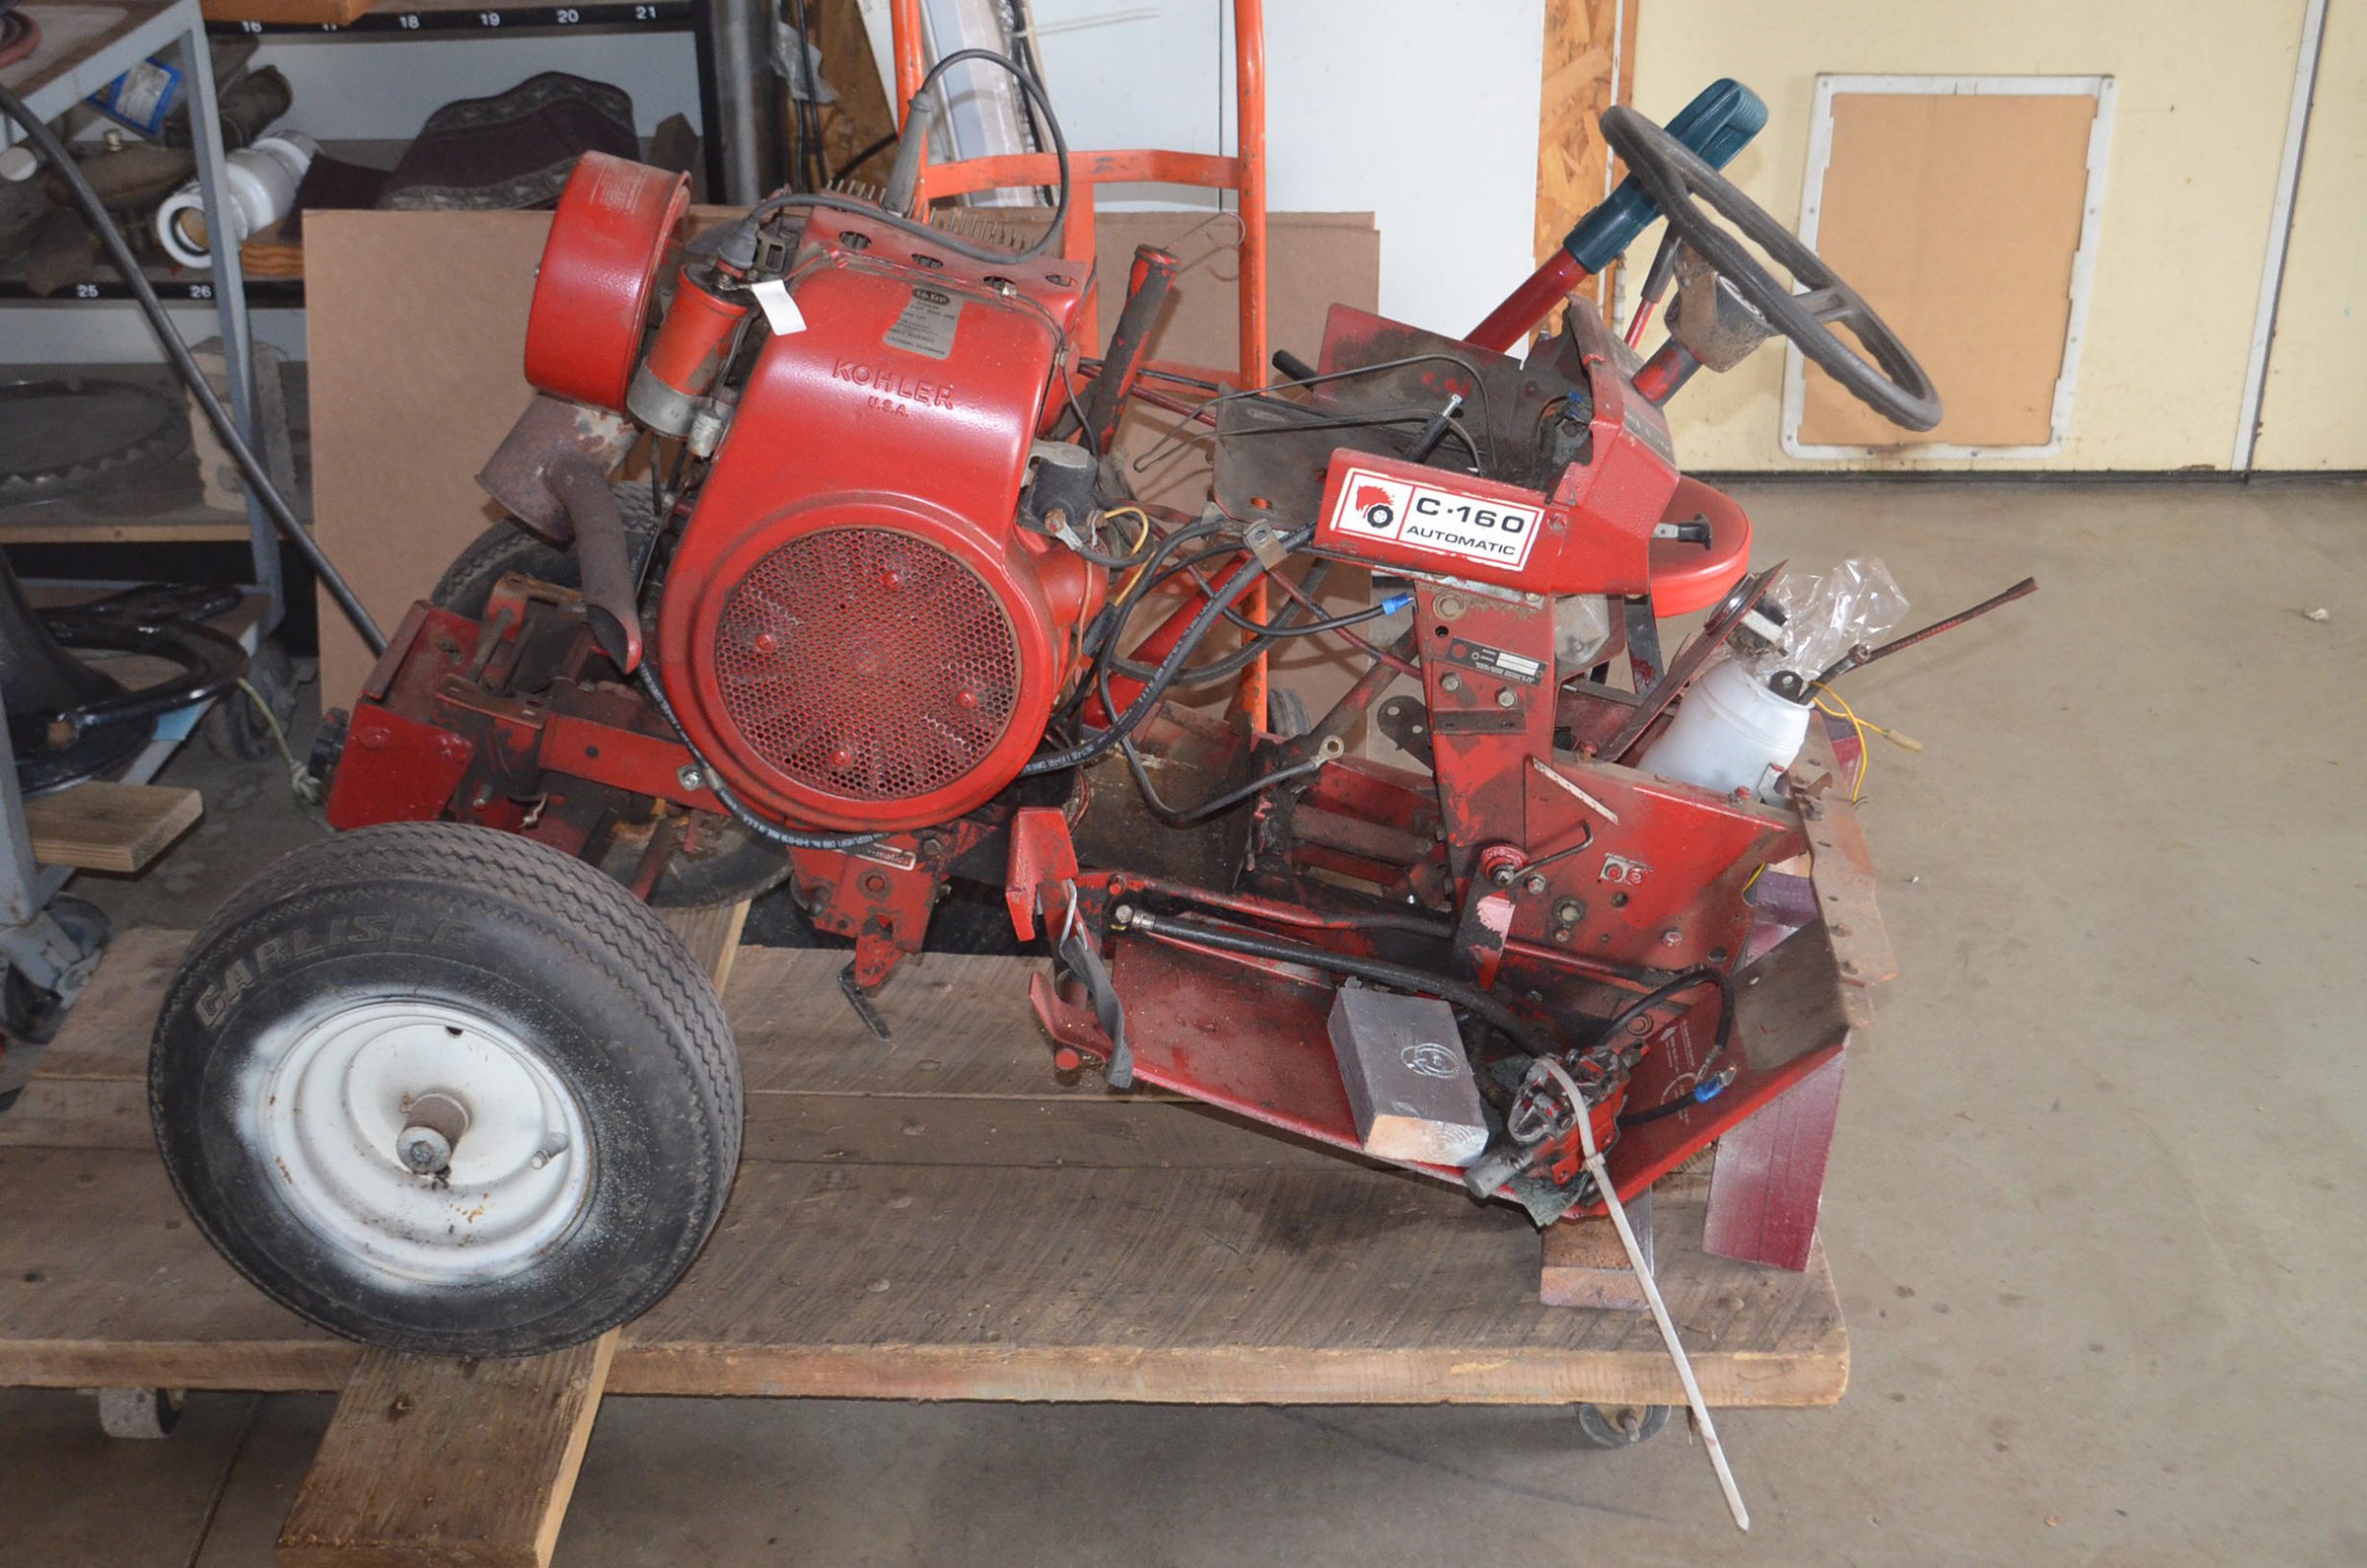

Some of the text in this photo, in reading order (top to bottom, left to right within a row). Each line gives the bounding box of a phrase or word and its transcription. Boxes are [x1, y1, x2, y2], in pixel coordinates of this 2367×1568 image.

[241, 20, 263, 34] 16
[399, 15, 420, 30] 18
[479, 12, 501, 27] 19
[556, 9, 580, 24] 20
[635, 5, 657, 20] 21
[77, 284, 212, 298] 25 26
[831, 358, 955, 410] KOHLER
[868, 395, 909, 418] U.S.A.
[1406, 525, 1516, 555] AUTOMATIC
[196, 913, 475, 1028] CARLISLE
